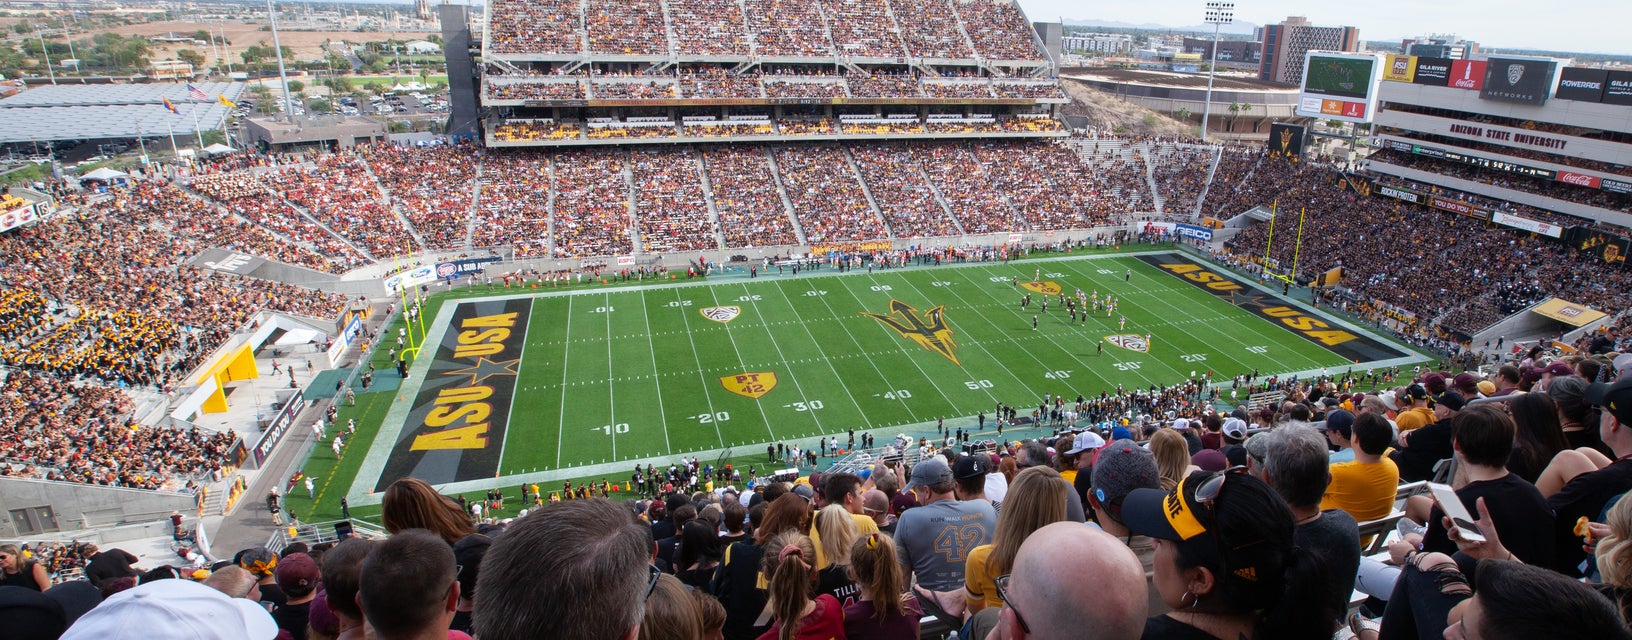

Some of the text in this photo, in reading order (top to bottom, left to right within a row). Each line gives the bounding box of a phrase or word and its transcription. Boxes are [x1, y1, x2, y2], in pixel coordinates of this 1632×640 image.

[1561, 80, 1601, 90] POWERADE
[1488, 91, 1533, 100] NETWORKS
[1450, 123, 1567, 150] ARIZONA STATE UNIVERSITY
[1563, 173, 1592, 186] Coca-Cola
[1398, 190, 1417, 202] PROTEIN
[1434, 199, 1469, 213] YOU DO YOU
[1177, 226, 1211, 240] GEICO
[463, 263, 476, 271] SUB
[1158, 263, 1245, 291] ASU
[1262, 306, 1359, 346] USA
[1245, 345, 1266, 355] 10
[1180, 353, 1206, 363] 20
[1112, 361, 1139, 371] 30
[735, 373, 759, 384] PT
[1045, 370, 1071, 380] 40
[409, 312, 519, 452] ASU USA
[964, 379, 995, 390] 50
[741, 384, 765, 394] 42
[884, 389, 912, 400] 40
[793, 400, 824, 412] 30
[698, 411, 730, 424] 20
[260, 412, 290, 457] YOU DO YOU
[603, 423, 629, 435] 10
[934, 522, 985, 563] 42
